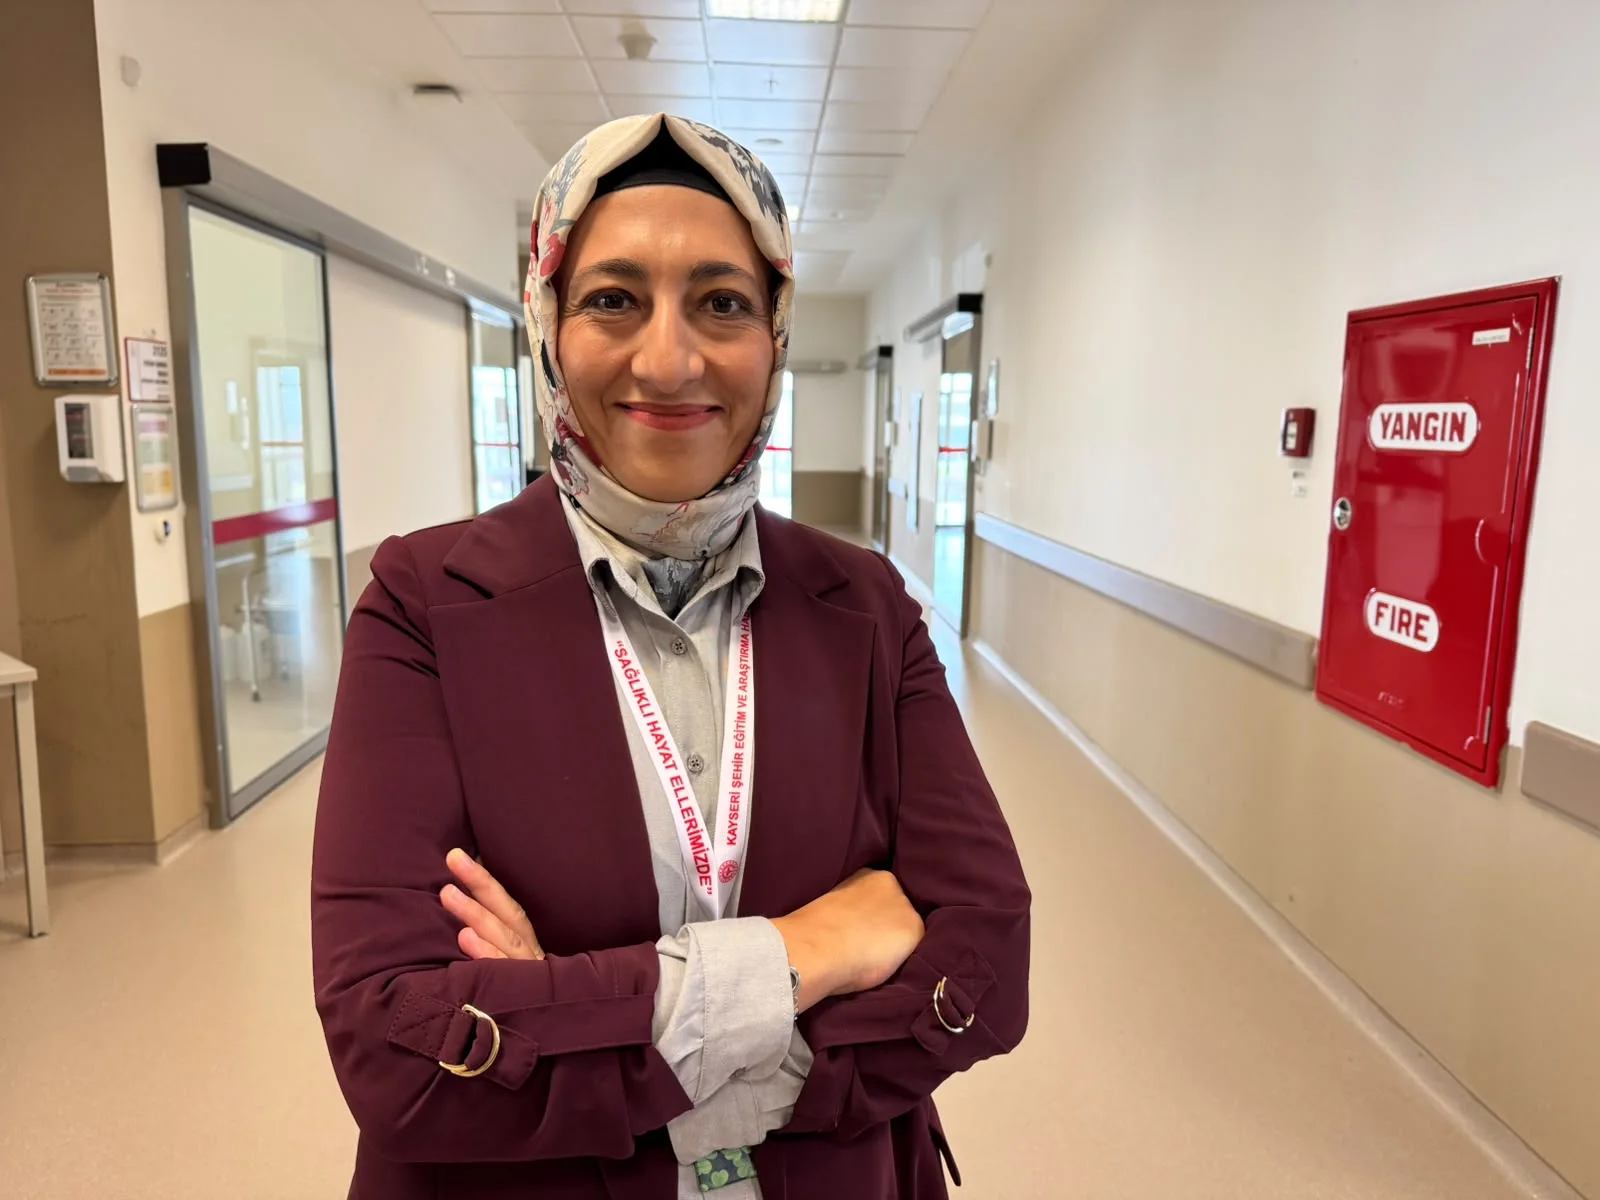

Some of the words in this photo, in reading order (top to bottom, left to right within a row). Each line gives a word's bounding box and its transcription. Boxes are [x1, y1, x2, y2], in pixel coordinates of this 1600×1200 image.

[1380, 412, 1467, 442] YANGIN
[1375, 601, 1430, 643] FIRE
[738, 633, 751, 692] ARAŞTIRMA
[737, 694, 747, 708] VE
[646, 720, 678, 771] HAYAT
[733, 710, 747, 749] EĞİTİM
[731, 752, 745, 788] ŞEHİR
[726, 791, 741, 846] KAYSERİ
